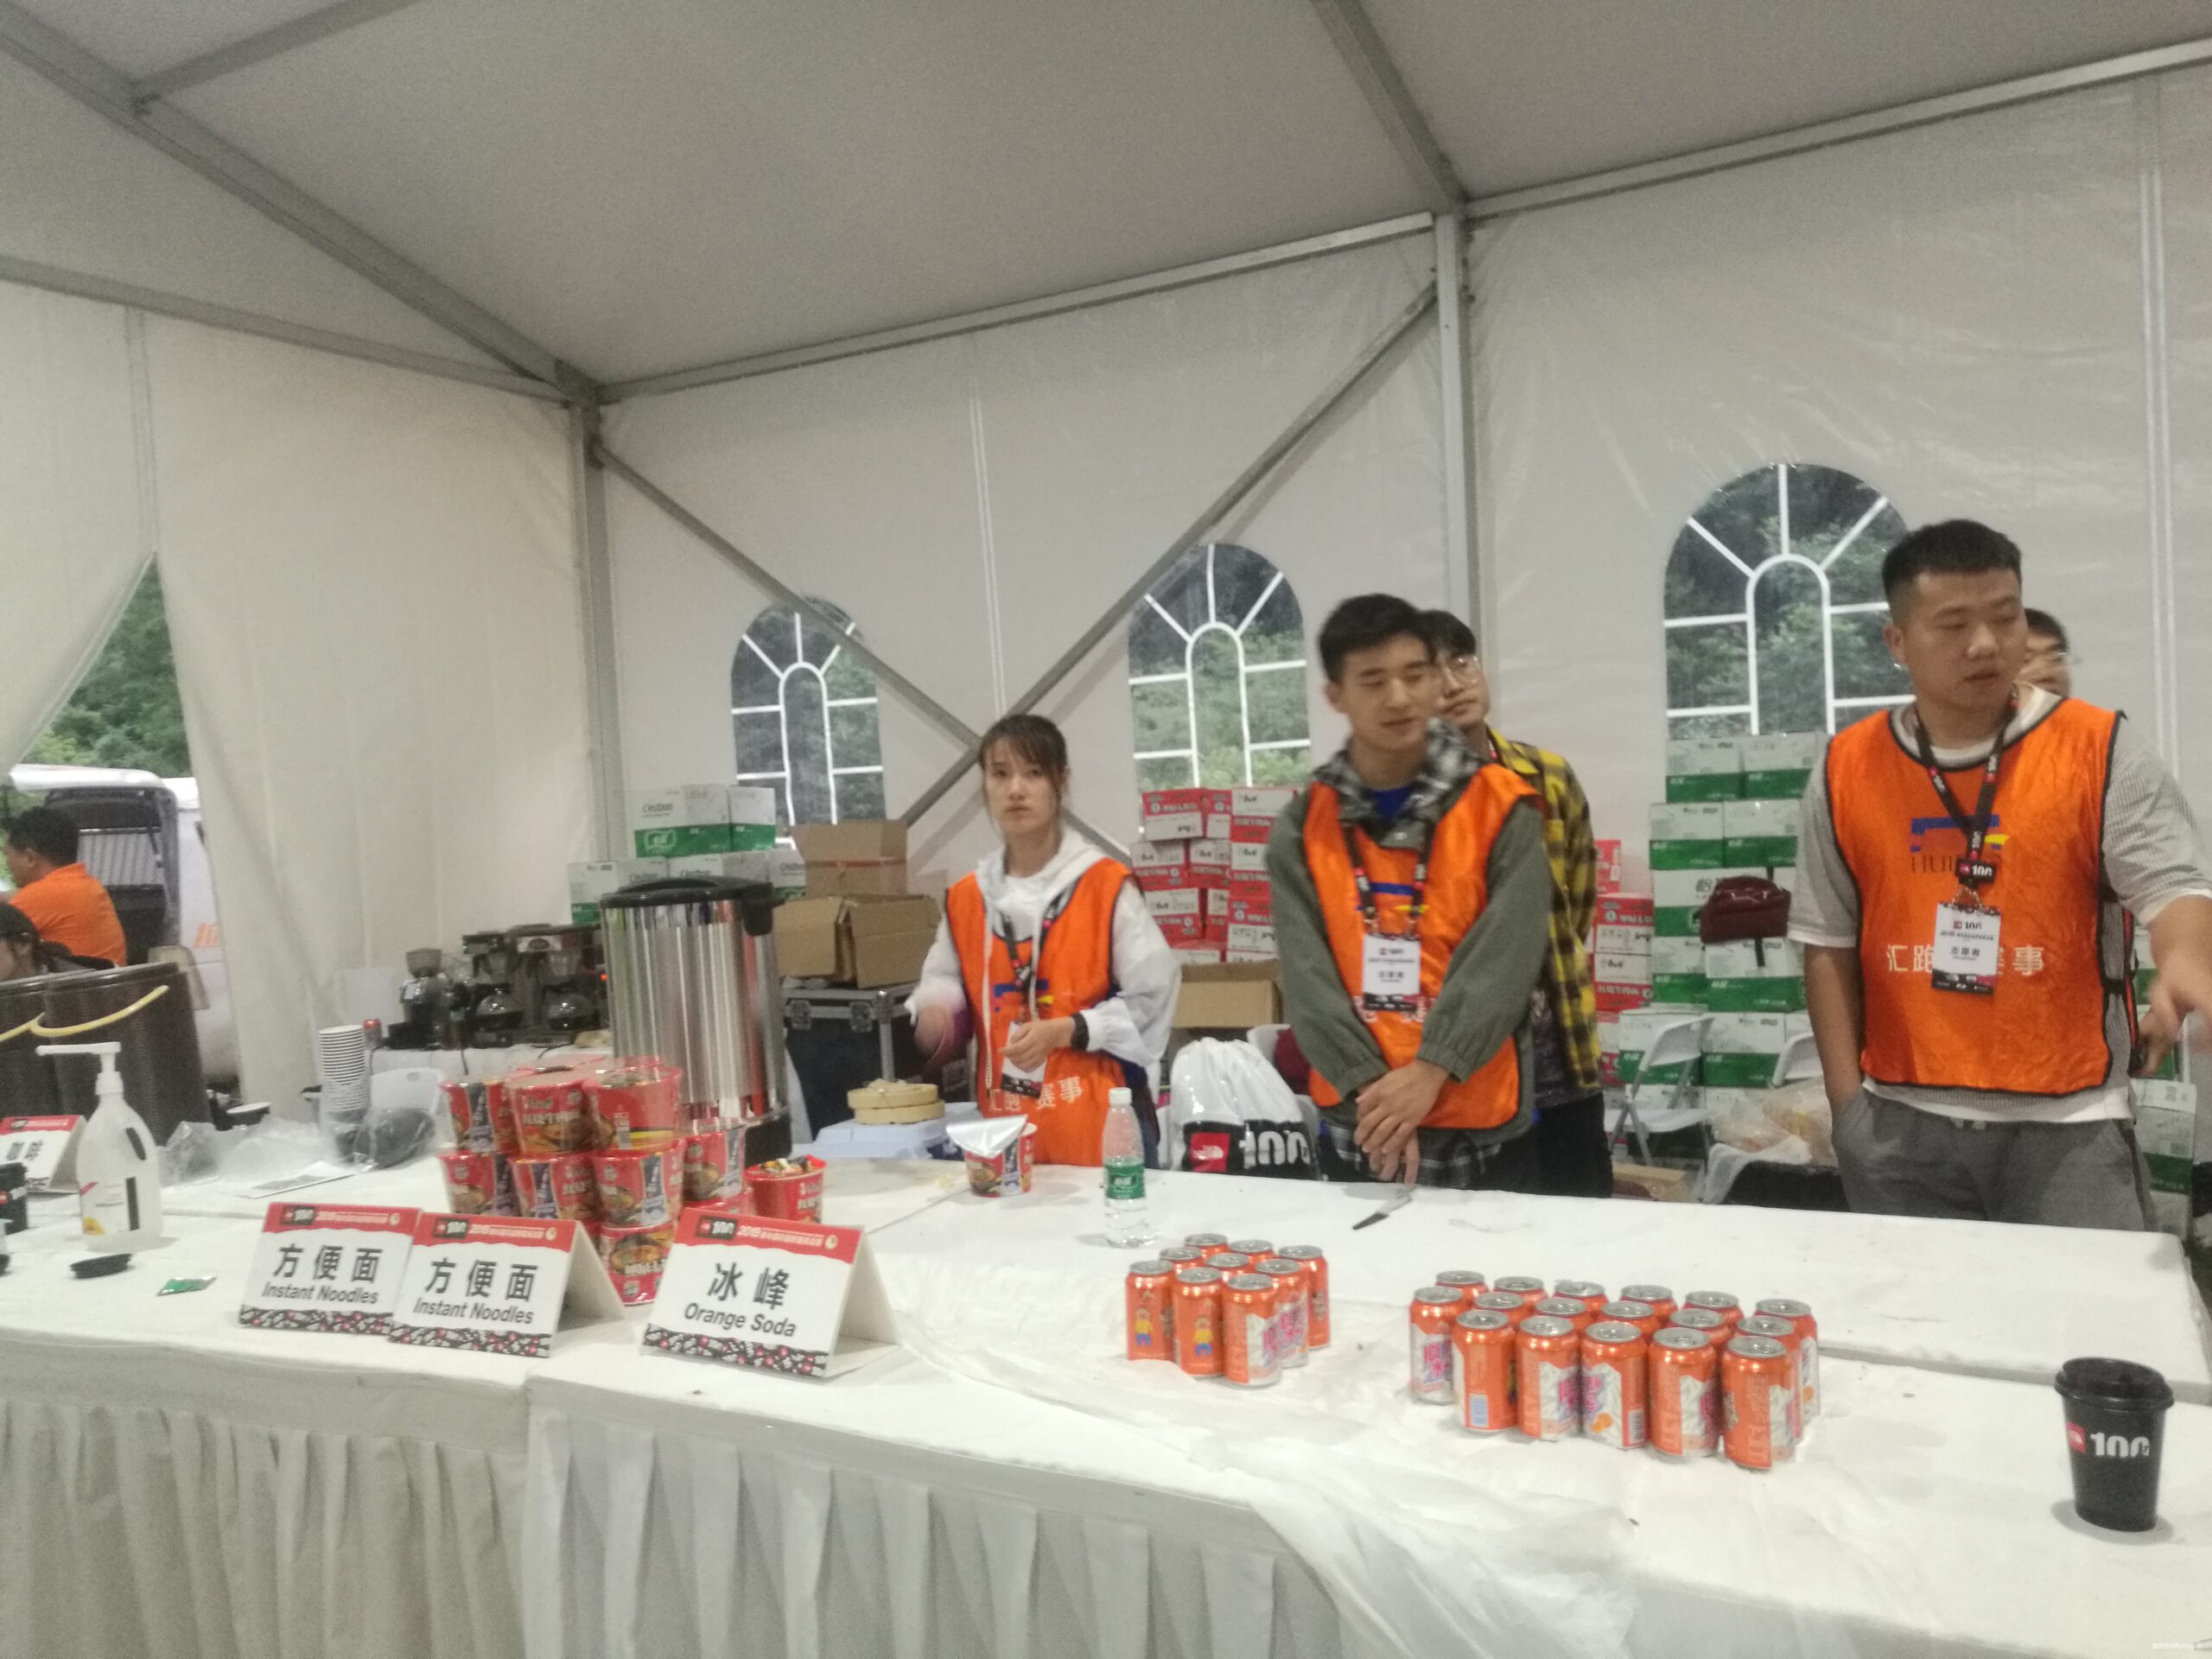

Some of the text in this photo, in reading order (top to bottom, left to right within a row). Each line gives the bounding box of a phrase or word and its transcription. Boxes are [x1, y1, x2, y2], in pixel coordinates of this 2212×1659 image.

[1238, 1123, 1311, 1170] 100
[272, 1243, 383, 1283] 方便面
[424, 1256, 538, 1302] 方便面
[261, 1281, 379, 1305] Instant Noodles
[707, 1262, 790, 1310] 冰峰
[412, 1296, 535, 1325] Instant Noodles
[683, 1302, 798, 1338] Orange Soda
[2090, 1431, 2151, 1459] 100
